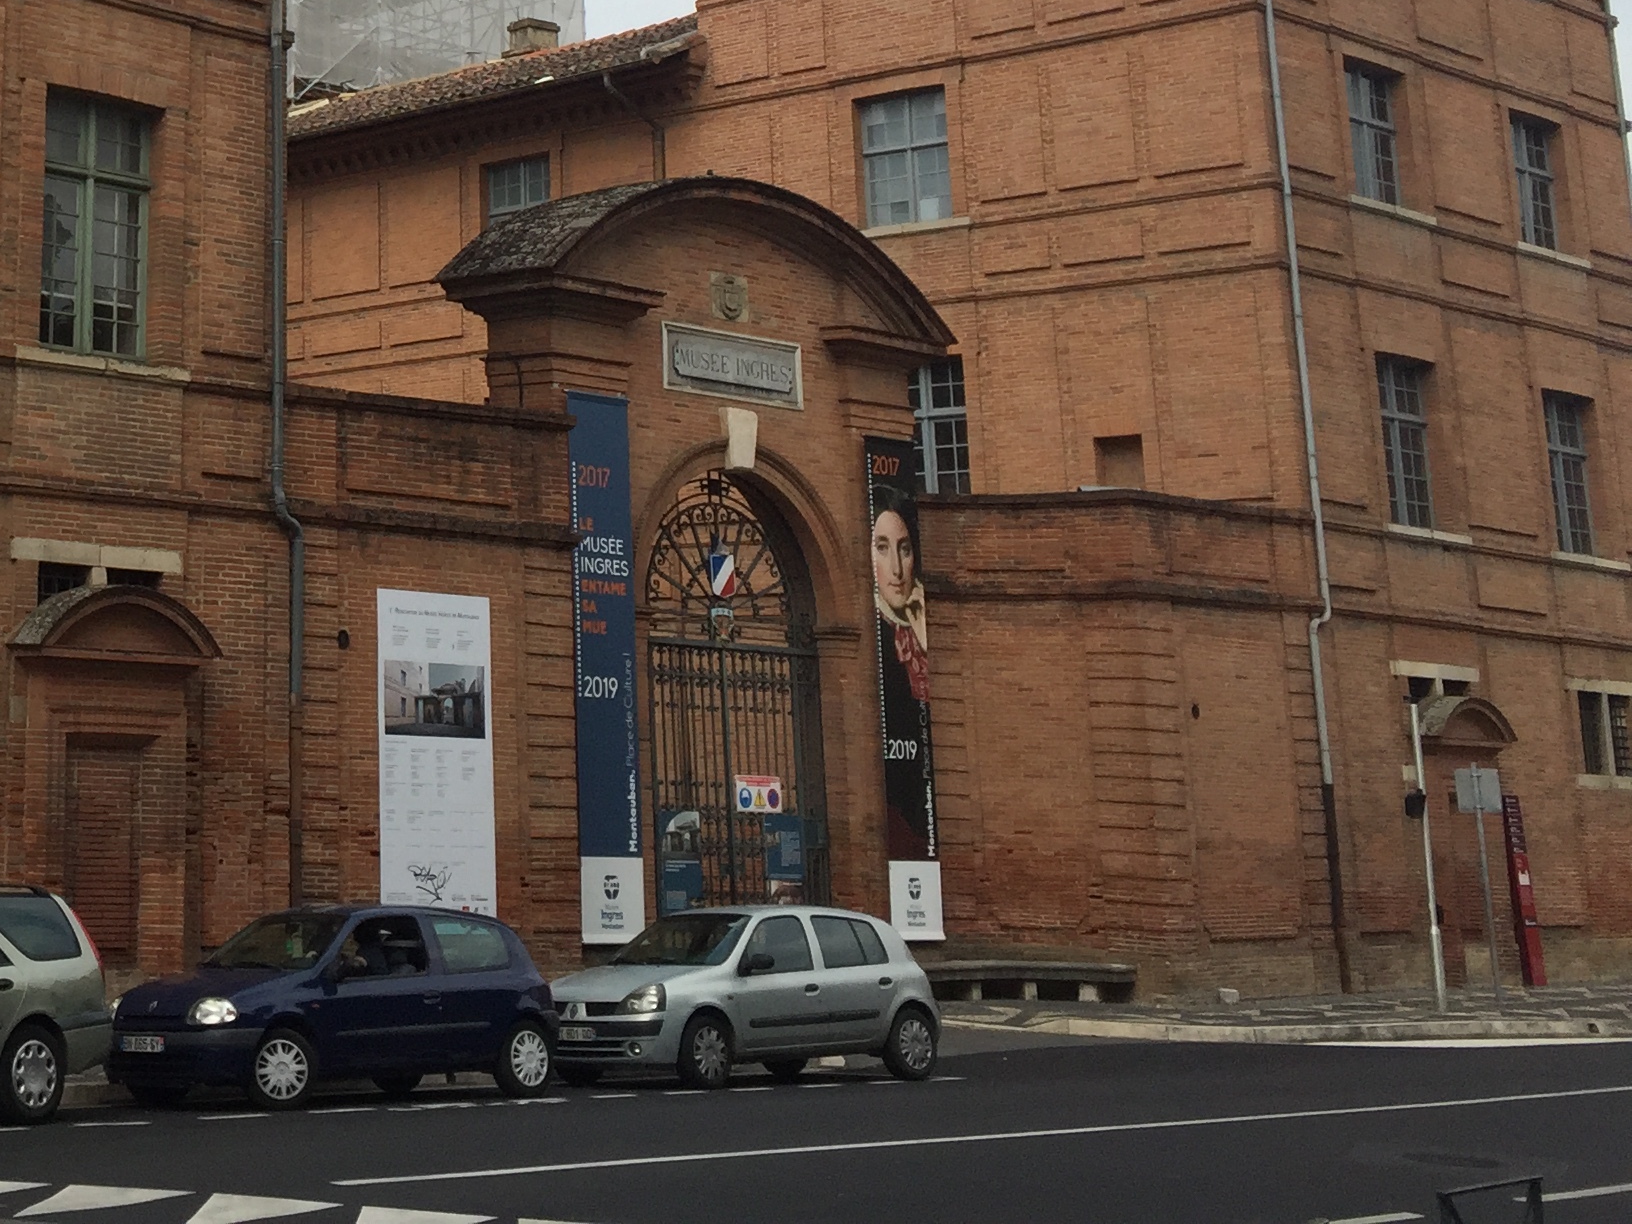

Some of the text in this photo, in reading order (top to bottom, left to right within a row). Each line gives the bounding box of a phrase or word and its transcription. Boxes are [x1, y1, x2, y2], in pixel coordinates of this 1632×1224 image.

[736, 358, 788, 384] INGRES
[872, 455, 900, 476] 2017
[578, 465, 611, 488] 2017
[579, 517, 594, 532] LE
[580, 535, 624, 555] MUSÉE
[581, 556, 629, 577] INGRES
[581, 579, 627, 596] ENTAME
[582, 619, 608, 635] MUE
[583, 676, 619, 699] 2019
[623, 659, 633, 709] Culture
[626, 731, 636, 767] Place
[888, 739, 918, 760] 2019
